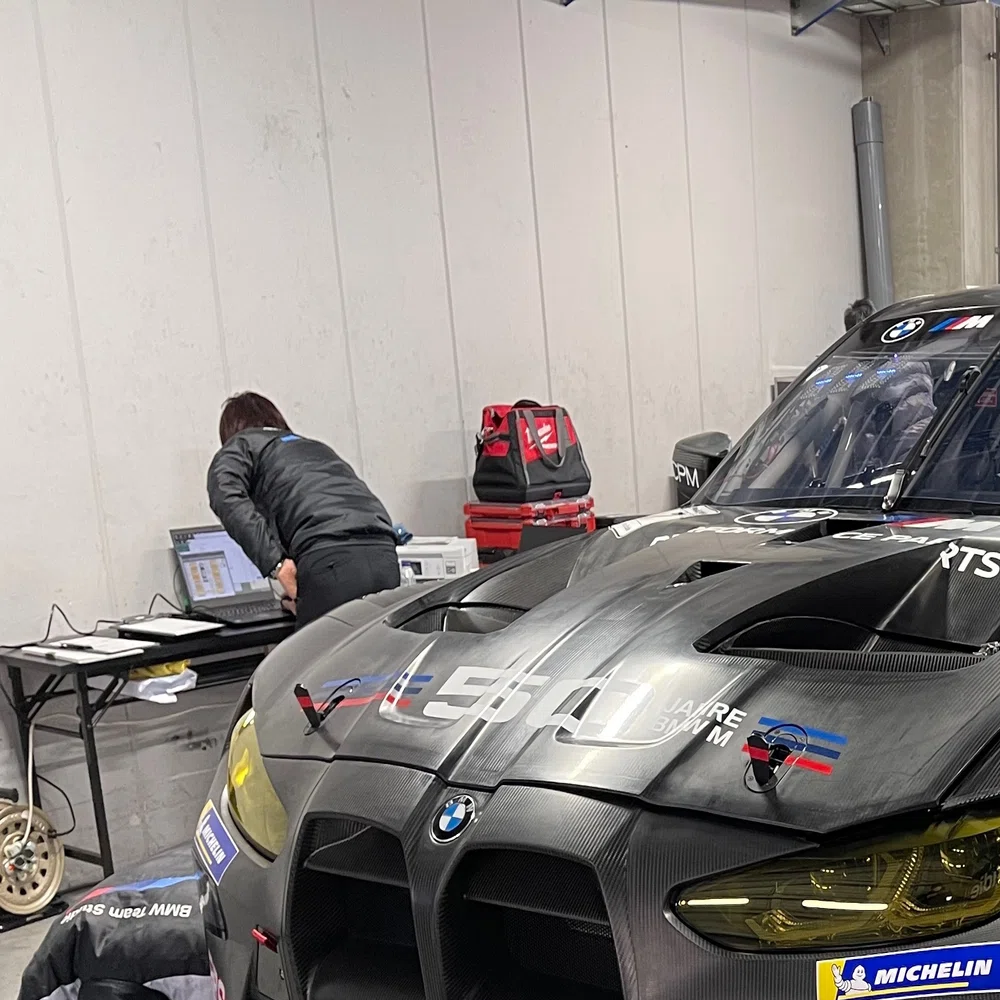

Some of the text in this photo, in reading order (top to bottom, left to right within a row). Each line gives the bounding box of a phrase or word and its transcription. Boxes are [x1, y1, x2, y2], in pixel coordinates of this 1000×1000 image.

[423, 665, 656, 729] 50
[705, 725, 734, 748] M
[202, 821, 226, 865] MICHELIN
[108, 905, 147, 920] Team
[148, 902, 193, 918] BMW
[874, 959, 993, 985] MICHELIN
